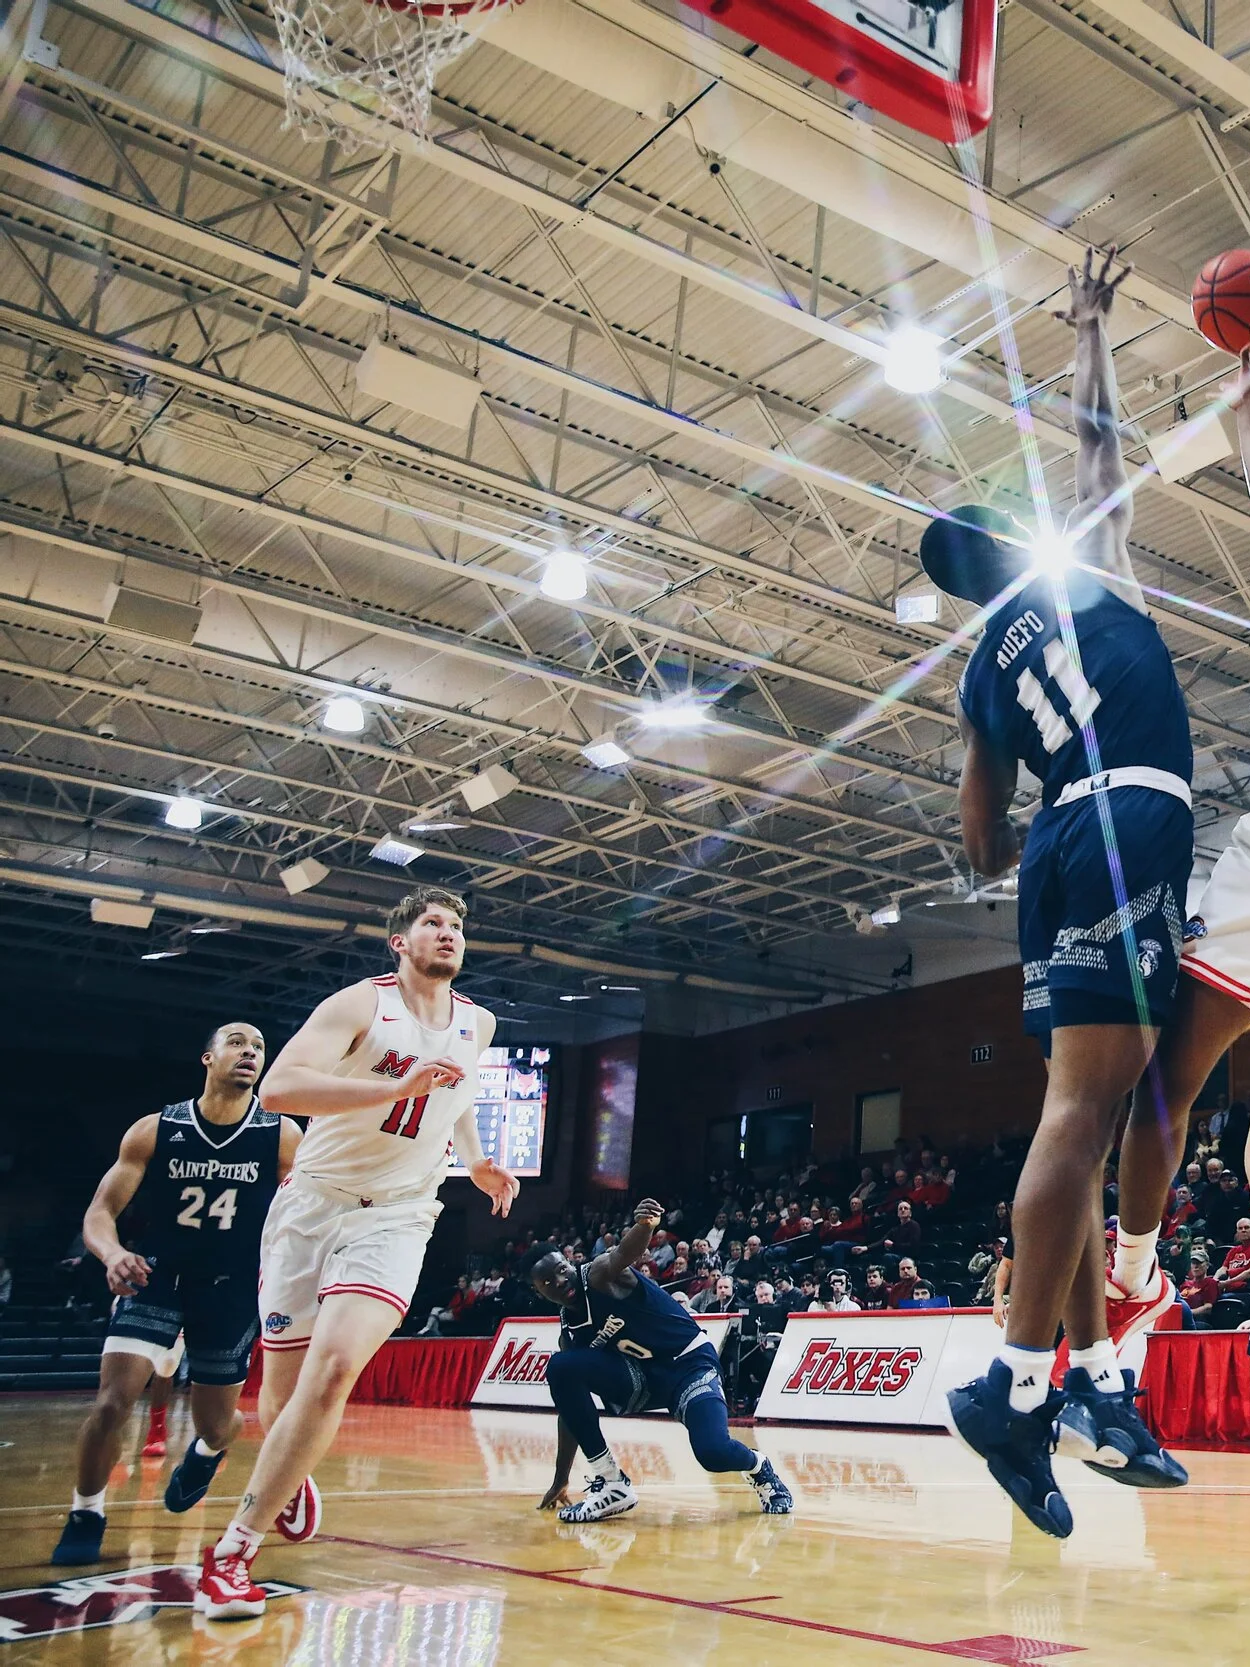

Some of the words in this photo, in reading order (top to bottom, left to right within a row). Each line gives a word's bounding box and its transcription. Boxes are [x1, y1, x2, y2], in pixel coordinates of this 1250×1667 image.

[1016, 636, 1102, 755] 11
[974, 1047, 990, 1062] 112
[380, 1093, 430, 1140] 11
[176, 1186, 239, 1231] 24
[483, 1337, 553, 1385] MAR
[781, 1338, 923, 1397] FOXES
